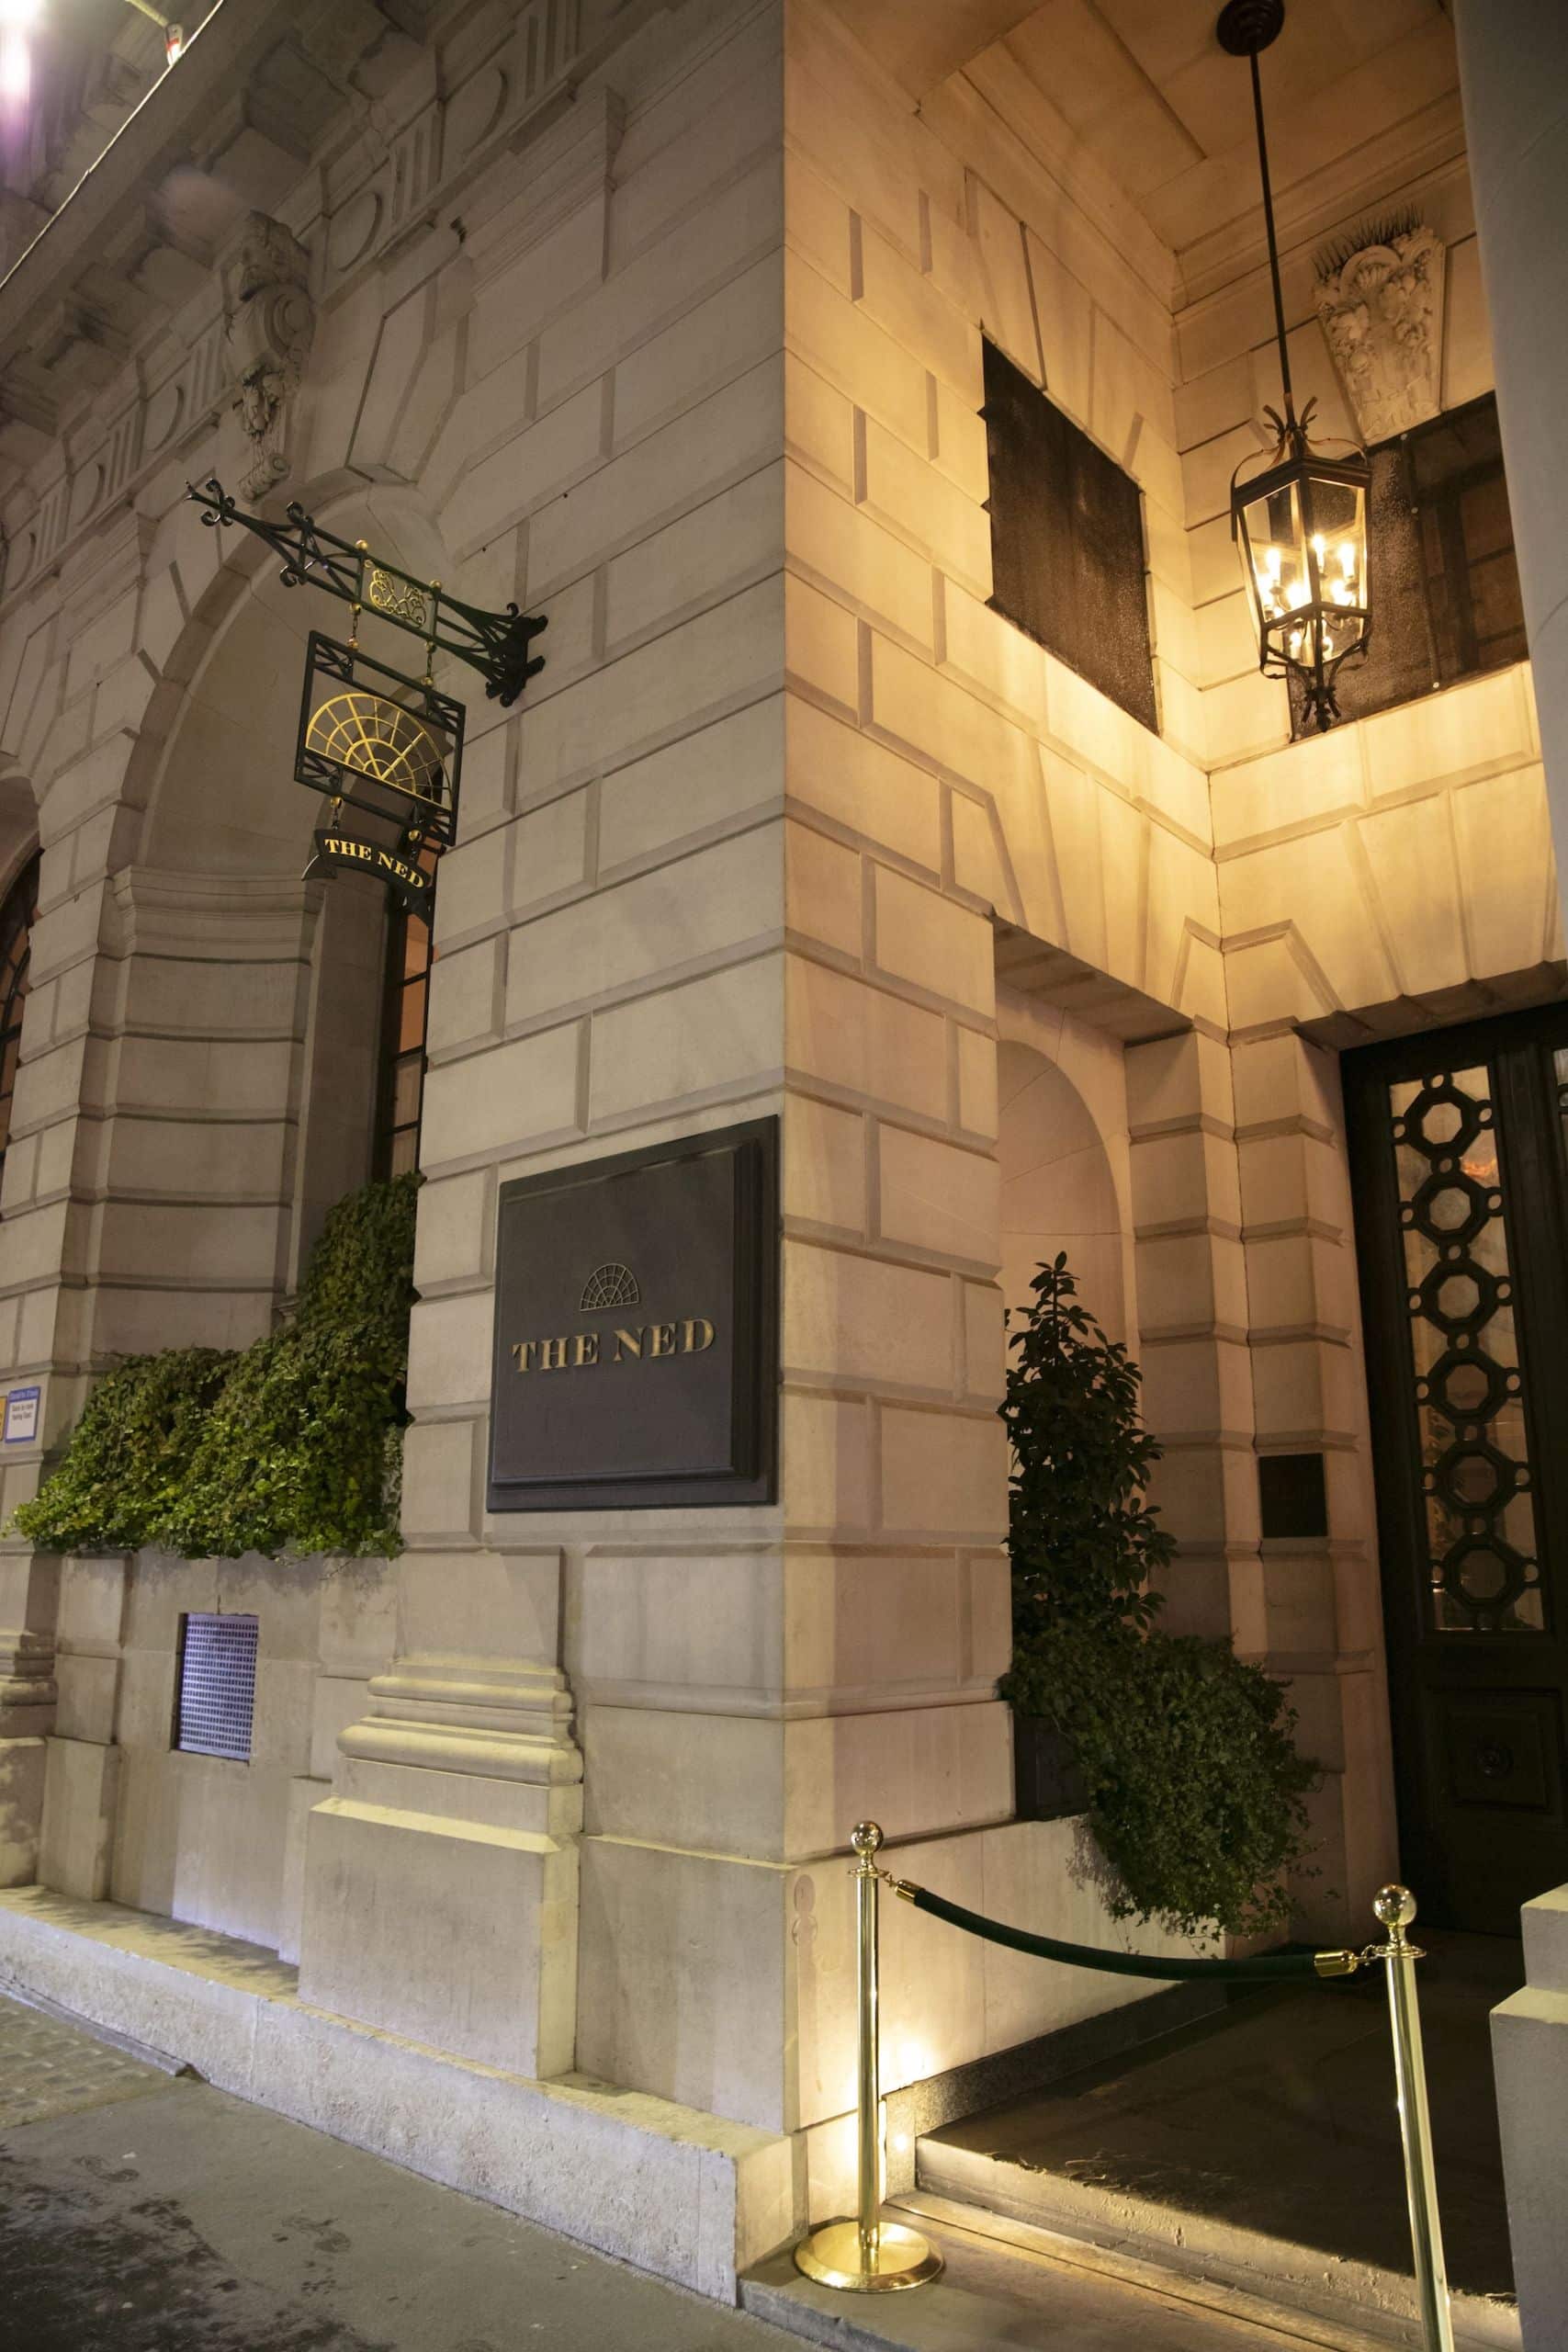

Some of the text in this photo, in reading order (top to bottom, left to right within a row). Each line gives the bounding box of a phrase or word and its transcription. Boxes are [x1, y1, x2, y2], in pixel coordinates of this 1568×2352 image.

[324, 838, 424, 888] THE NED
[512, 1317, 716, 1373] THE NED
